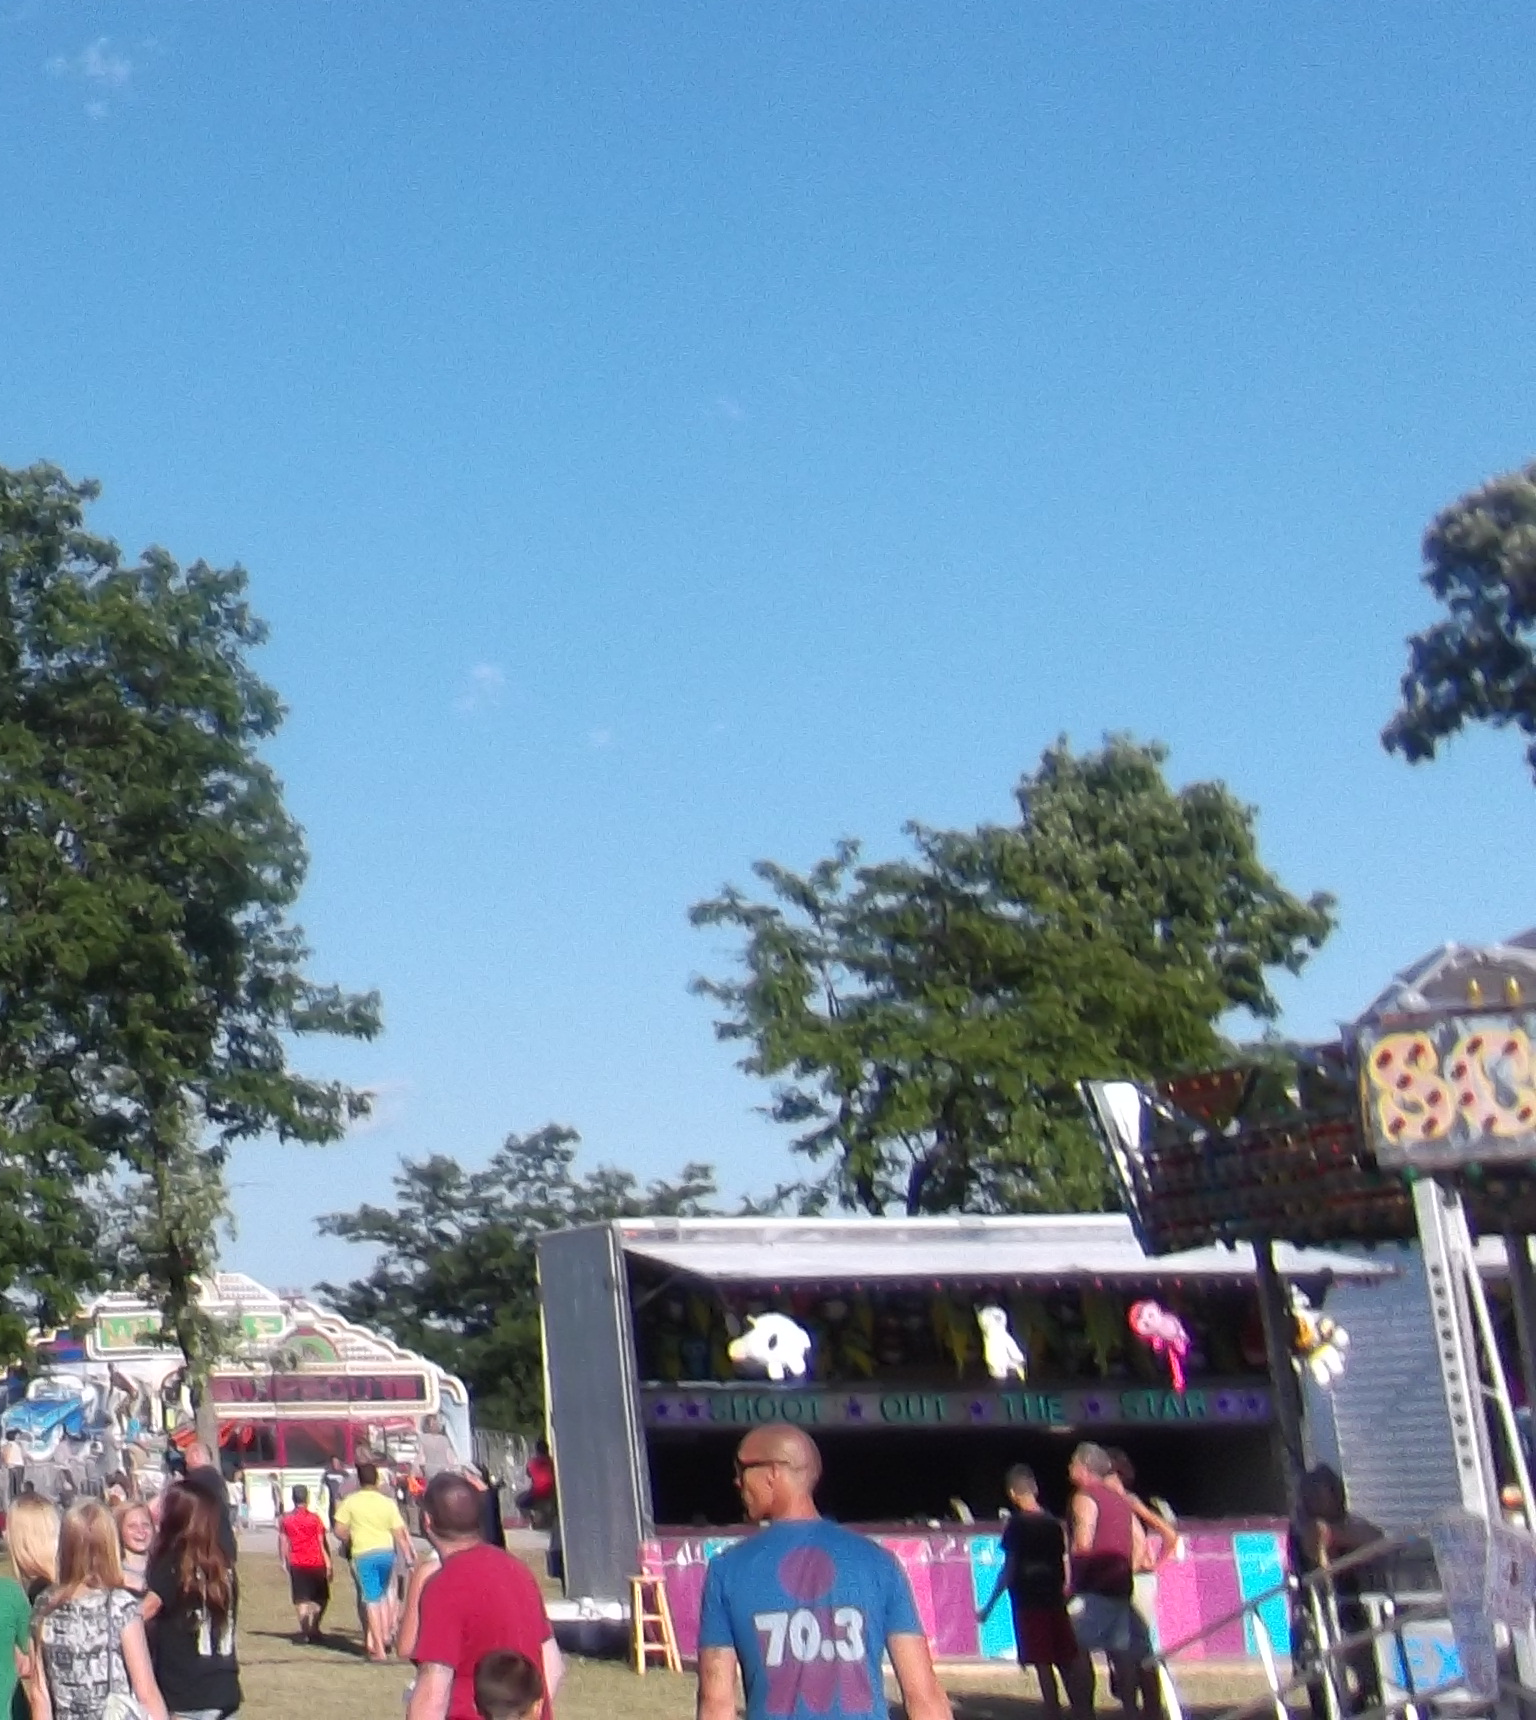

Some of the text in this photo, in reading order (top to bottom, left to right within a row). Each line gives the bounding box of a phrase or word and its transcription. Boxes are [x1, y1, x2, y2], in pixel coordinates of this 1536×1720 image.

[1369, 1029, 1536, 1146] SC
[708, 1389, 822, 1423] SHOOT
[879, 1390, 948, 1422] OUT
[997, 1388, 1066, 1426] THE
[753, 1606, 866, 1668] 70.3
